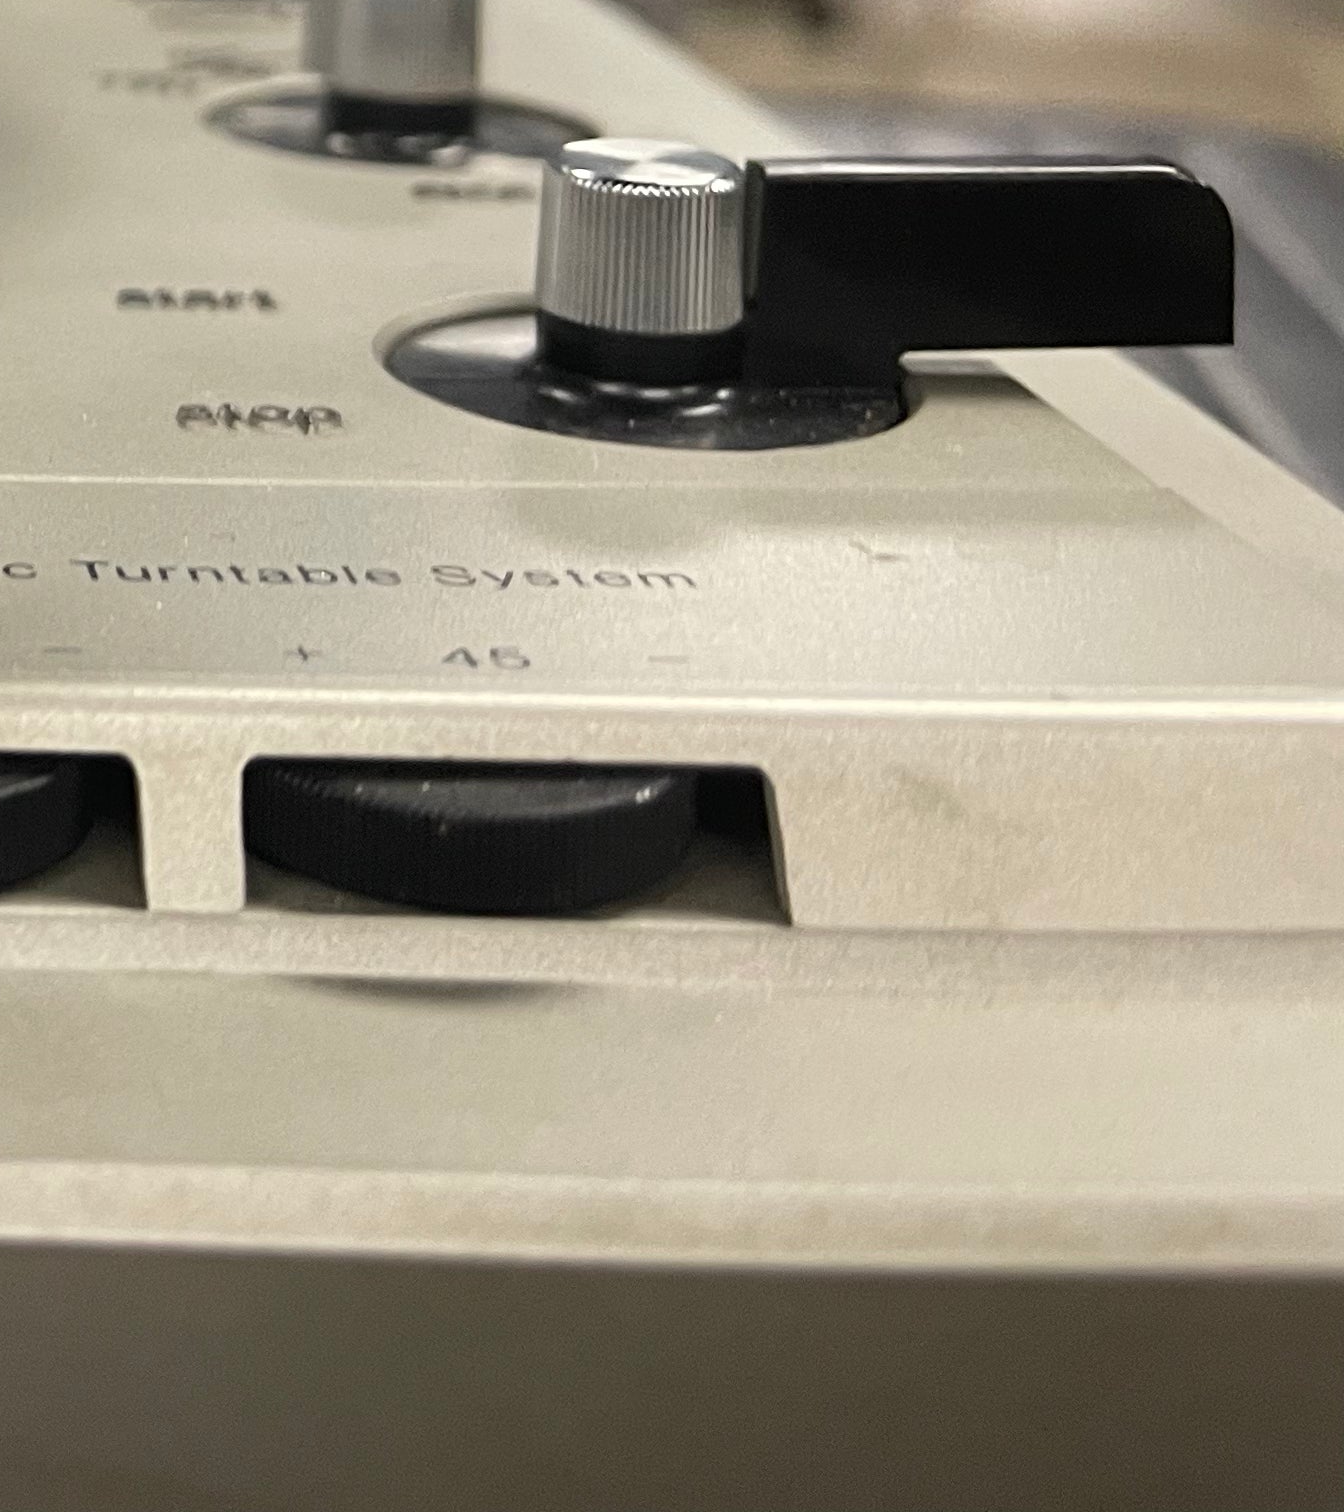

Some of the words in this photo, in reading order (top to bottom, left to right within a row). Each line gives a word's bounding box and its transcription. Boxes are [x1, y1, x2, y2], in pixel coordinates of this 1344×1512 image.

[69, 558, 402, 586] Turntable
[429, 564, 698, 589] System
[441, 646, 530, 669] 45
